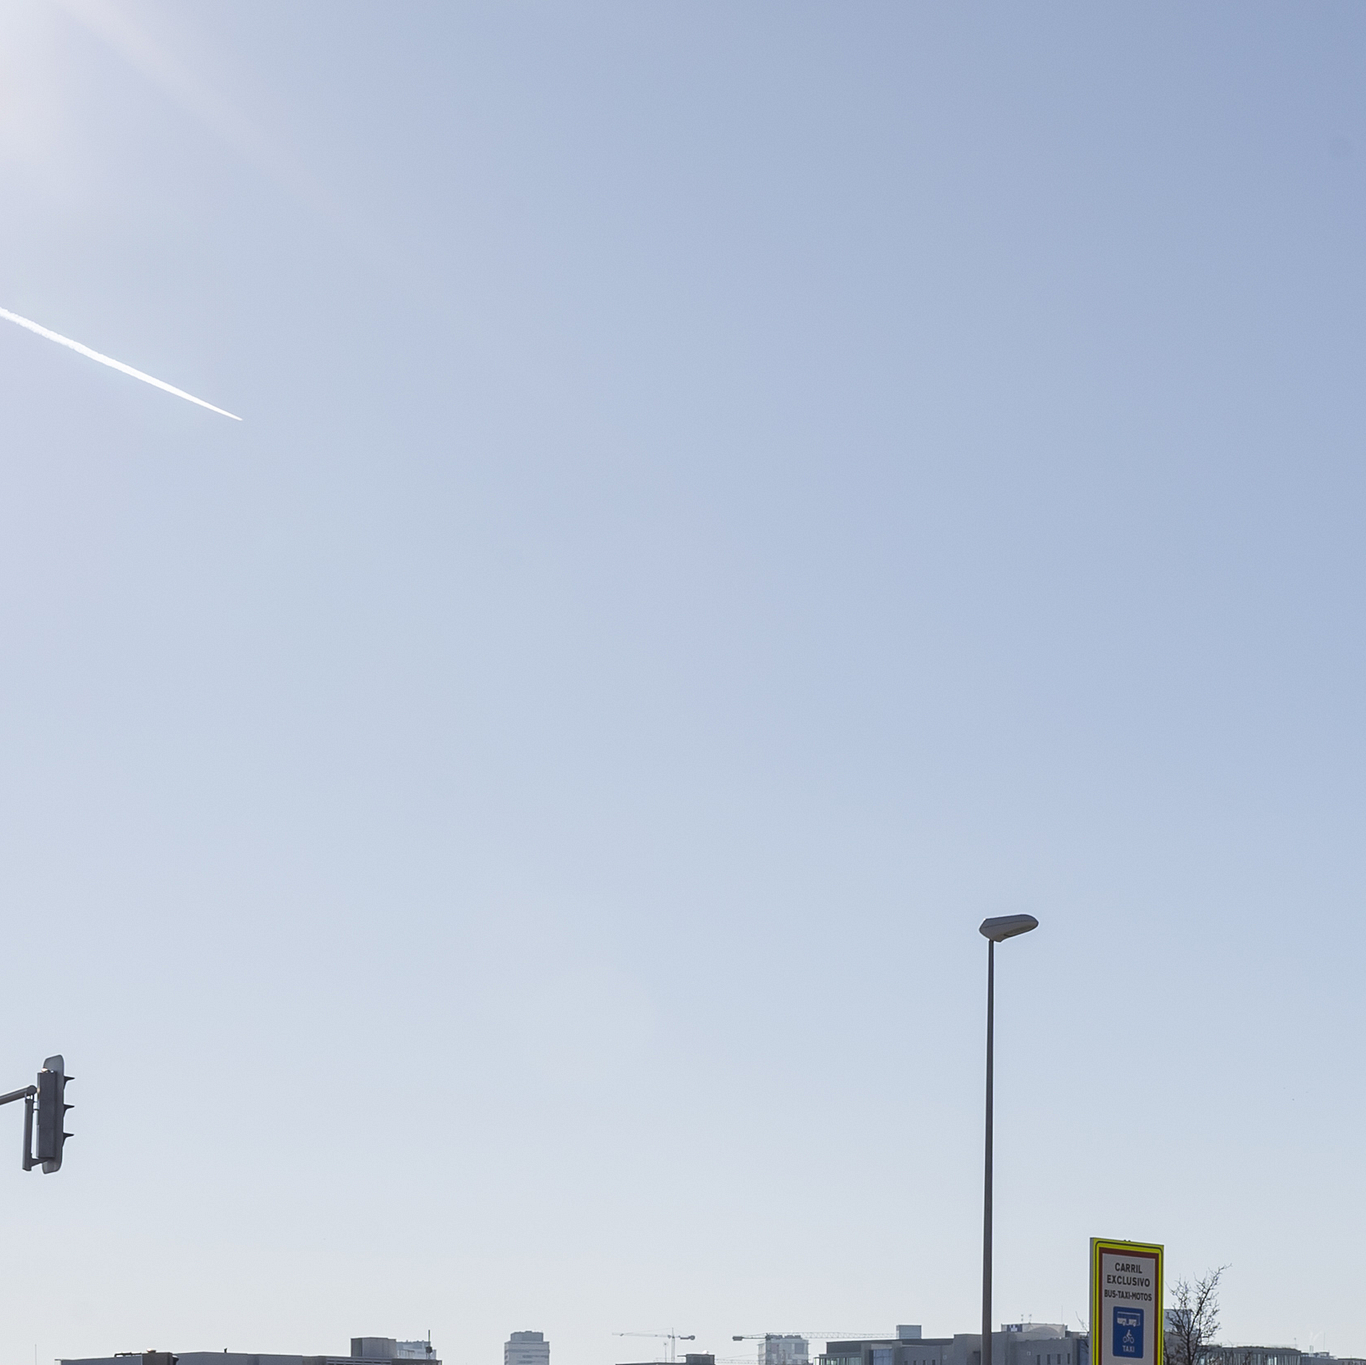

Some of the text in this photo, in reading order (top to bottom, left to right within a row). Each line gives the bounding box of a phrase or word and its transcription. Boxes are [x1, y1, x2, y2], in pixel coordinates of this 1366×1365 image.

[1115, 1262, 1142, 1274] CARRIL
[1106, 1274, 1150, 1287] EXCLUSIVO
[1104, 1289, 1152, 1302] BUS-TAXI-MOTOS
